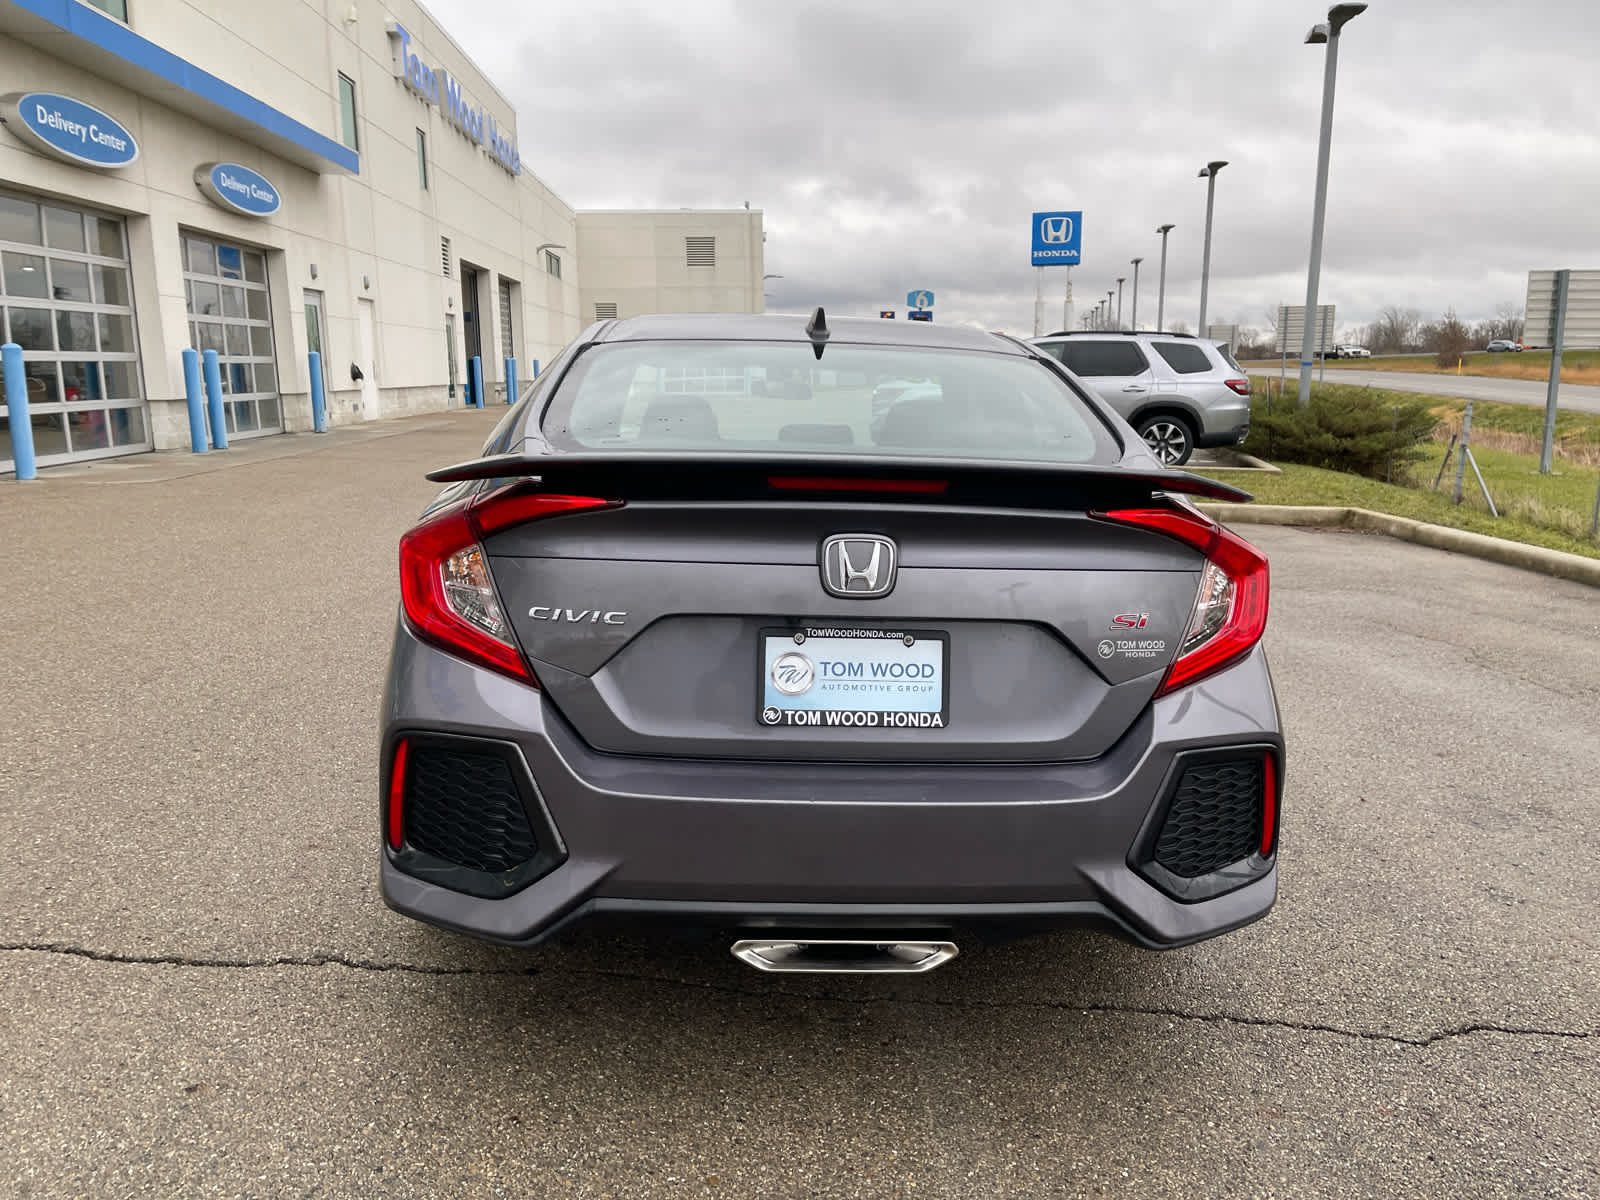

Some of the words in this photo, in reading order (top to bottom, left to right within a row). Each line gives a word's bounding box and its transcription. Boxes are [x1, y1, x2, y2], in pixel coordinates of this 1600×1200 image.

[396, 23, 438, 105] Tom
[443, 69, 484, 145] Wood
[488, 113, 521, 176] Honda
[36, 104, 87, 143] Delivery
[89, 125, 127, 152] Center
[220, 171, 250, 197] Delivery
[251, 184, 274, 204] Center
[528, 606, 627, 625] CIVIC
[1116, 640, 1136, 649] TOM
[1138, 640, 1165, 649] WOOD
[819, 661, 864, 677] TOM
[870, 662, 935, 679] WOOD
[822, 683, 891, 692] AUTOMOTIVE
[897, 685, 933, 693] GROUP
[785, 710, 822, 726] TOM
[826, 711, 879, 727] WOOD
[883, 712, 944, 728] HONDA
